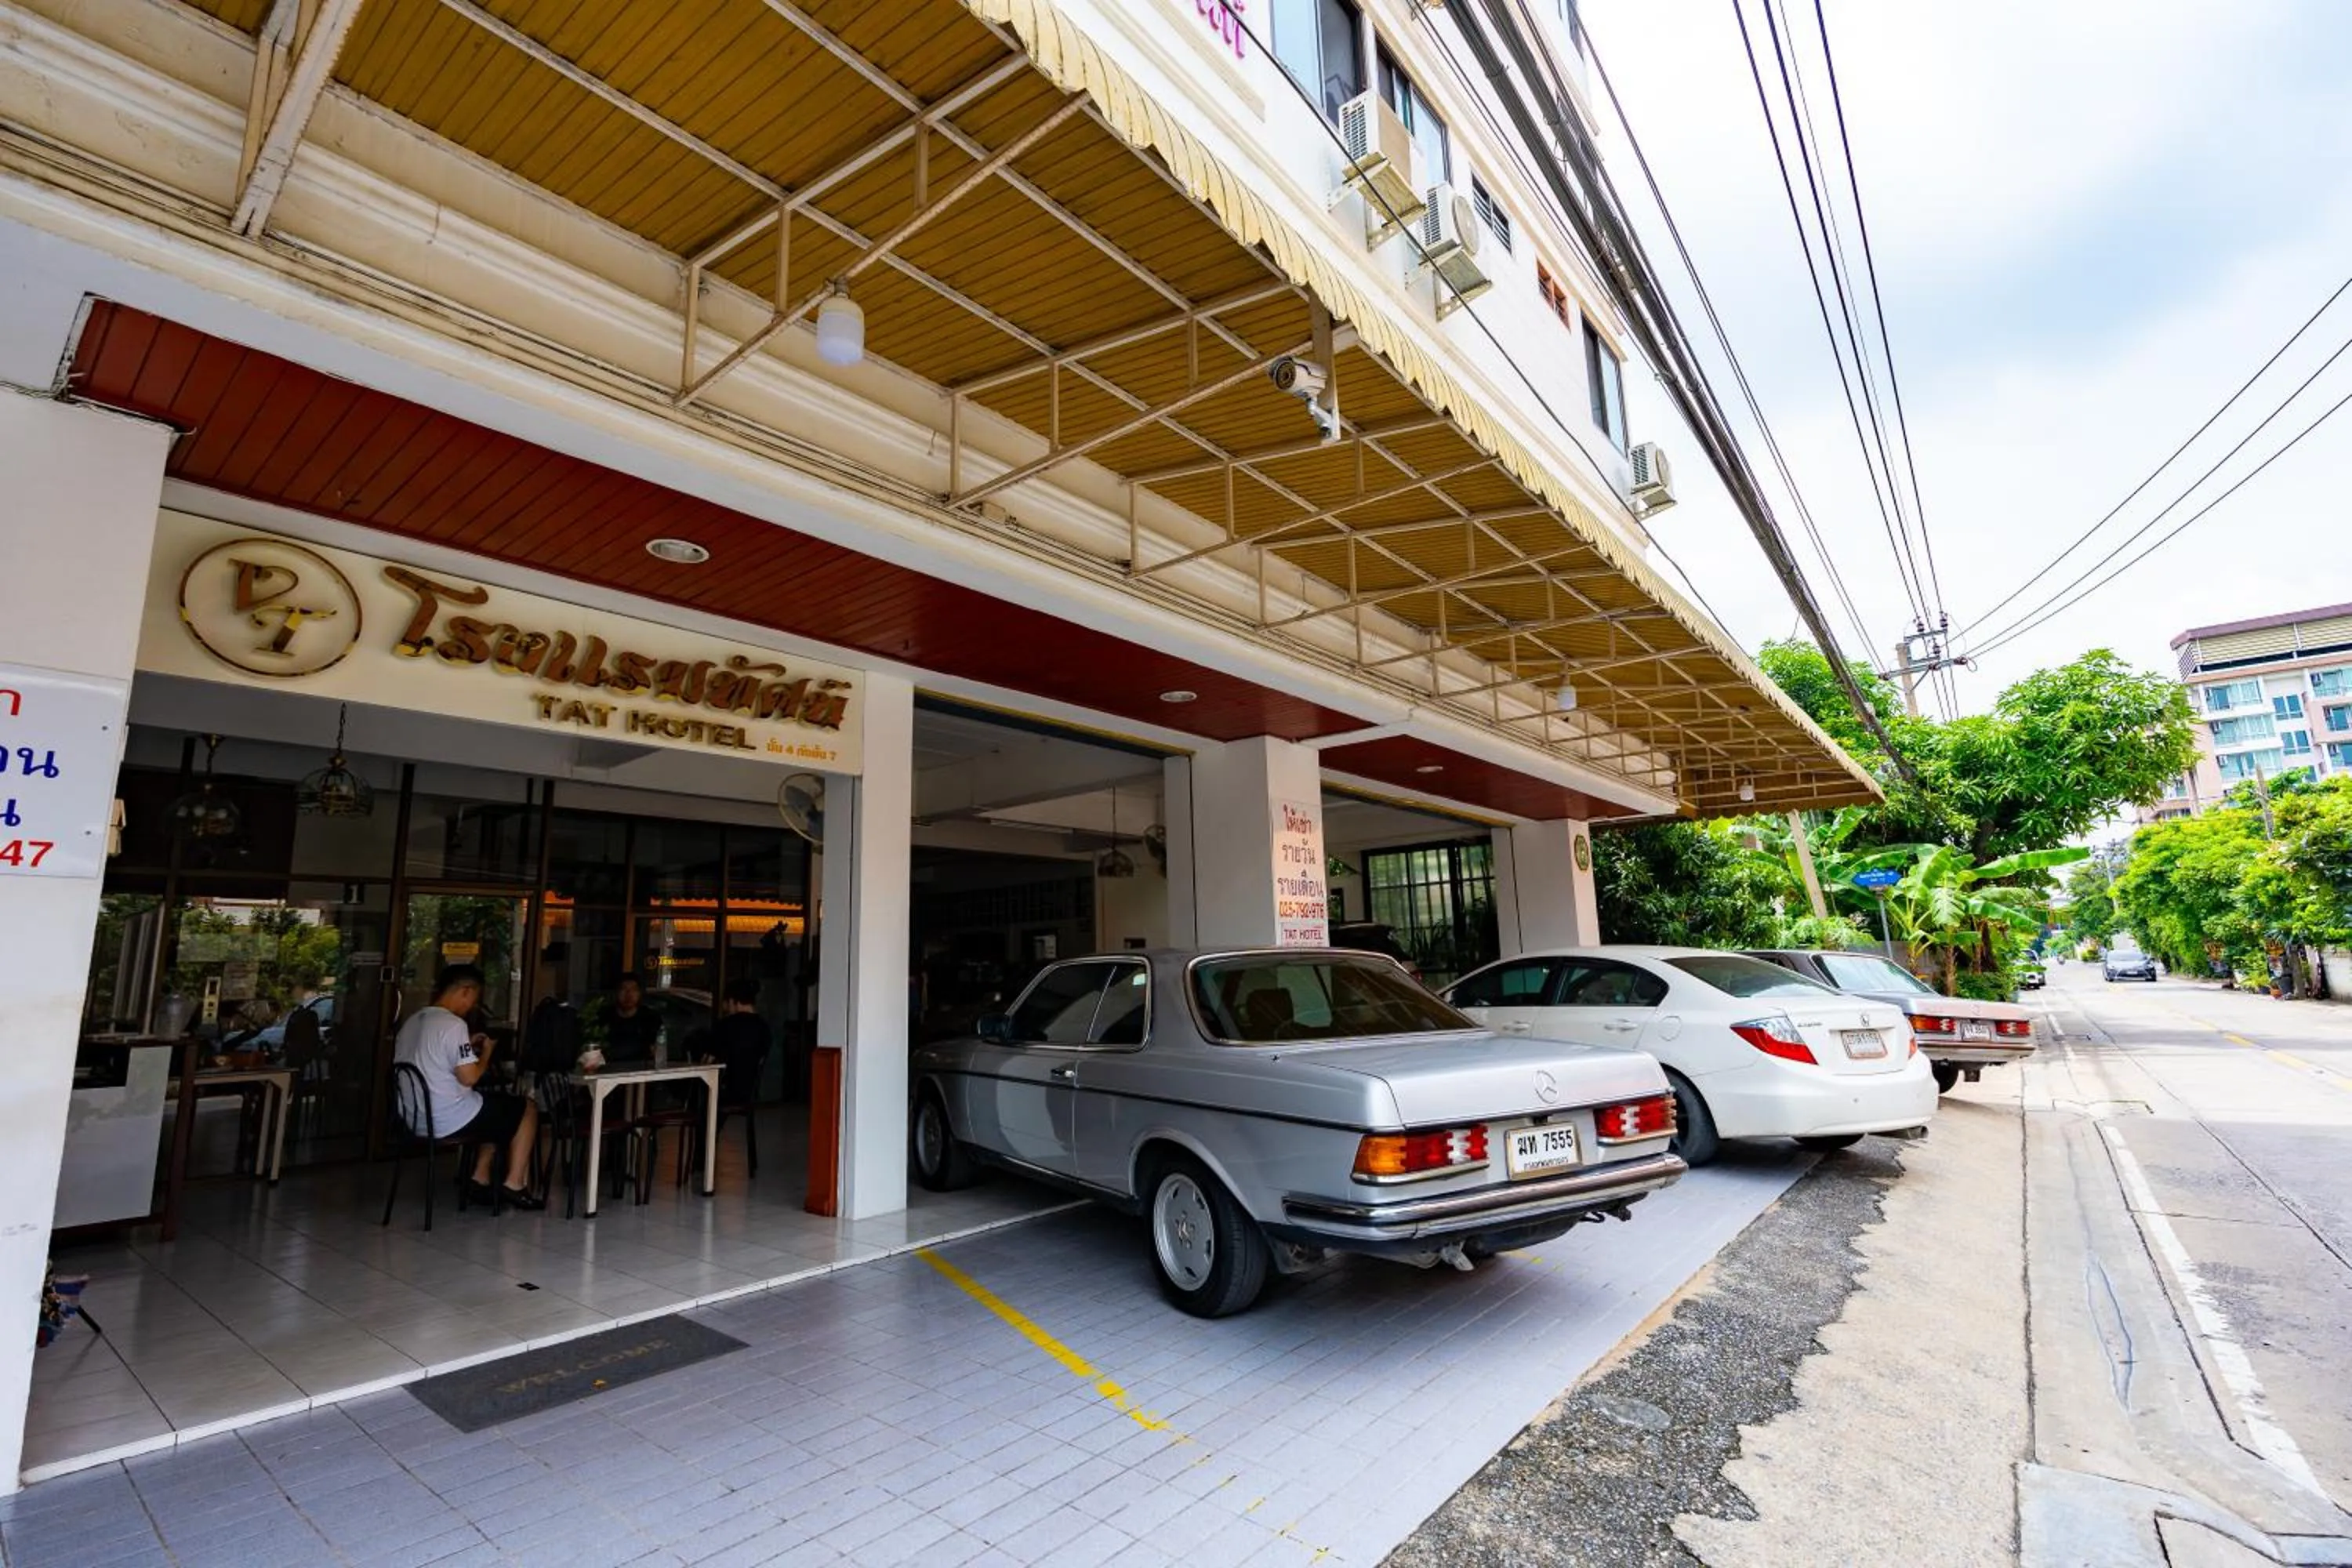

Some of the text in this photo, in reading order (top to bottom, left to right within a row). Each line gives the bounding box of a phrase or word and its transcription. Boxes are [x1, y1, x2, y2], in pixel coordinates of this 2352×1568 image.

[532, 693, 757, 750] TAT HOTEL
[1282, 838, 1316, 865] รายวัน
[1277, 869, 1324, 897] รายเดือน
[1283, 929, 1324, 940] TAT HOTEL
[1543, 1130, 1573, 1152] 7555
